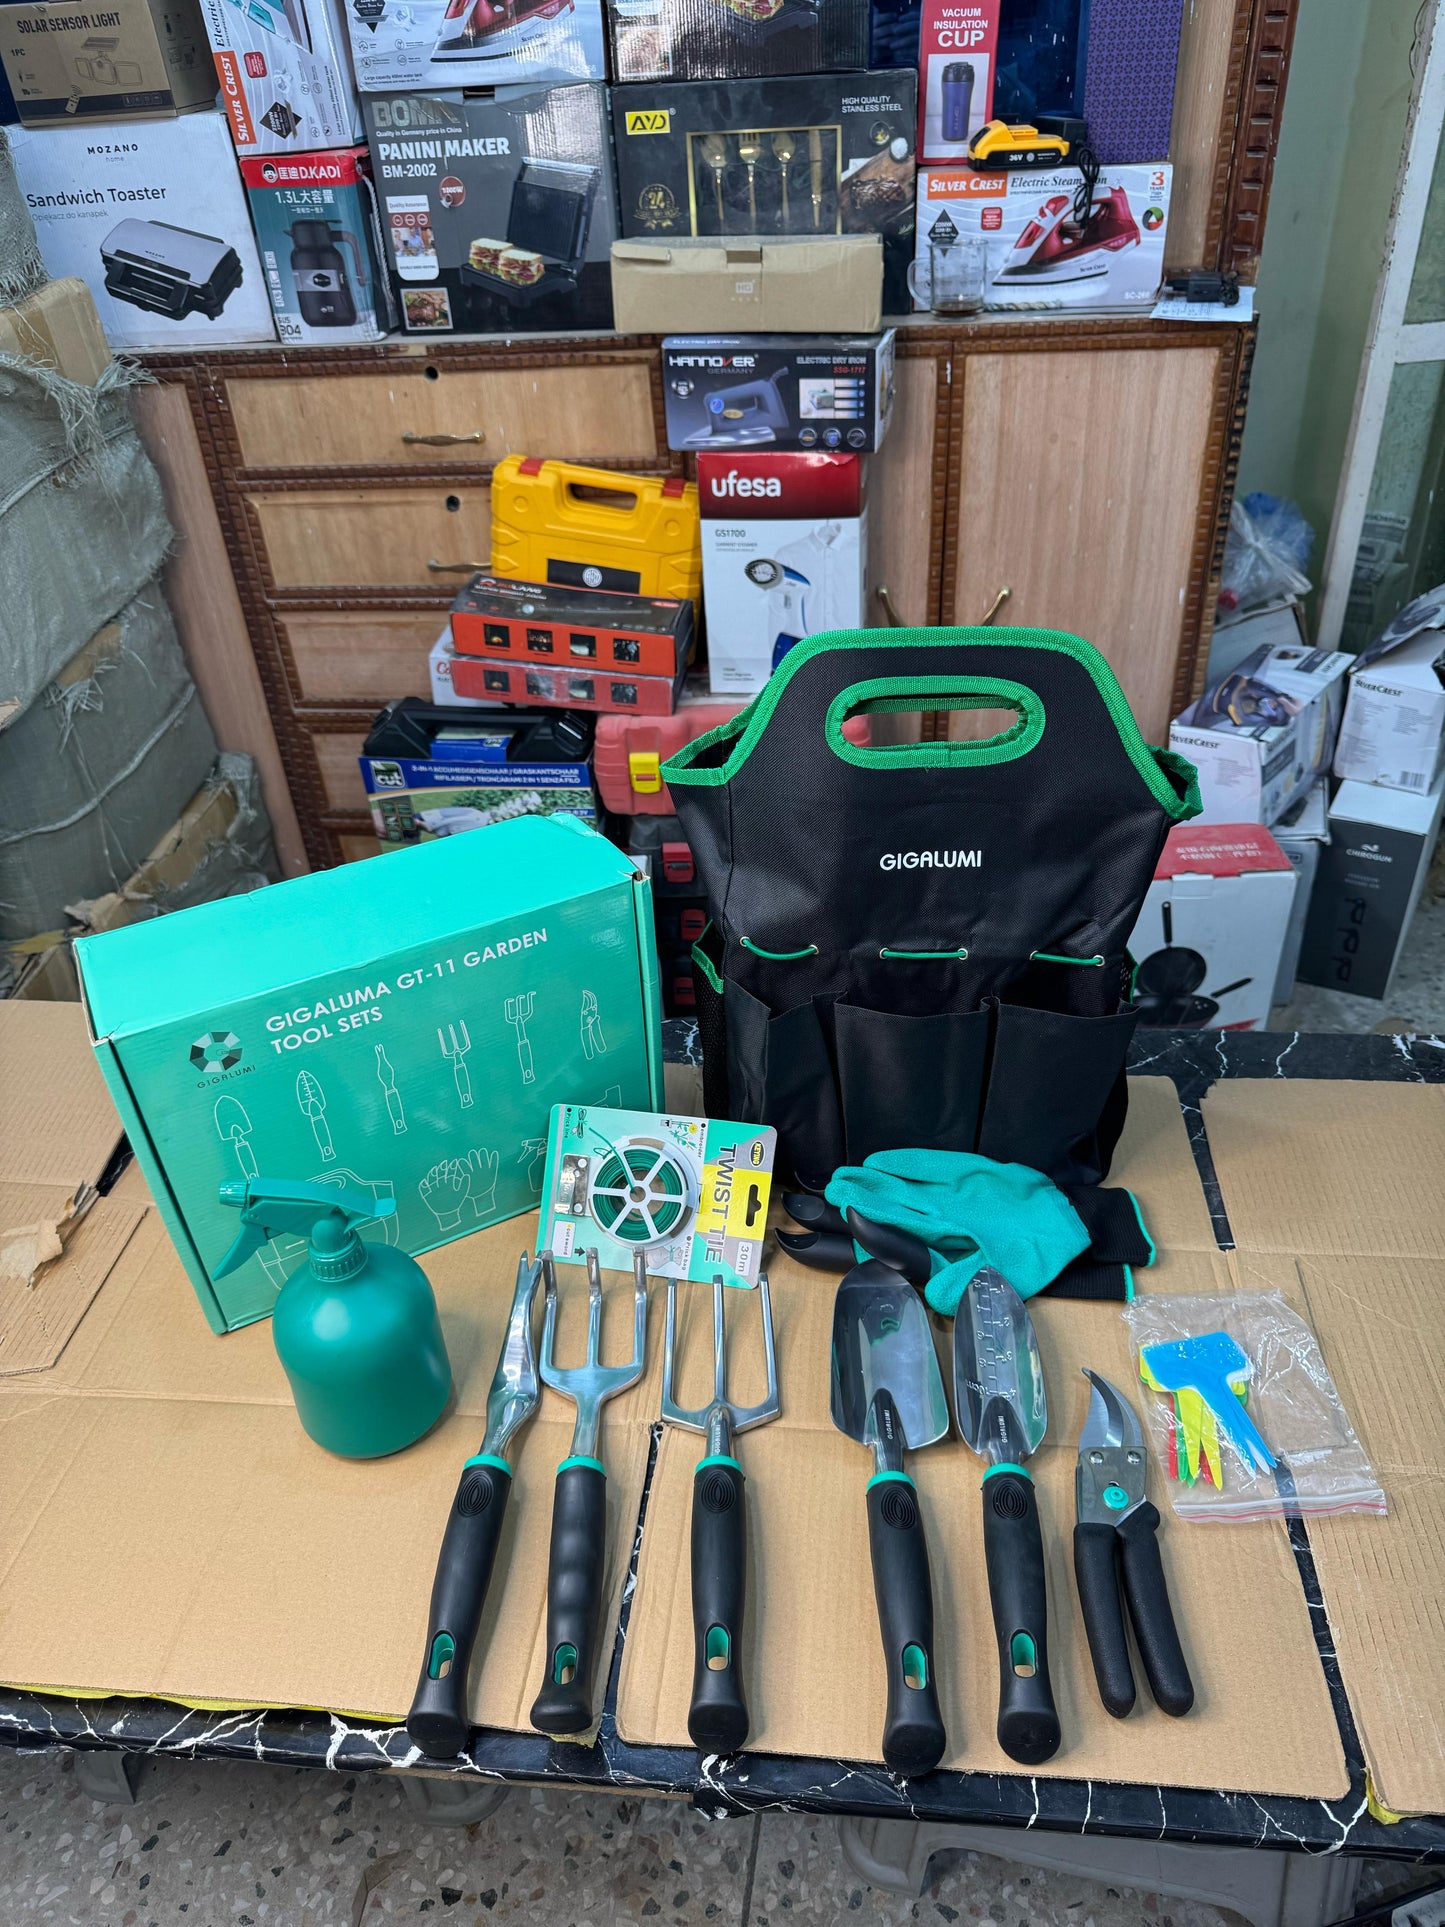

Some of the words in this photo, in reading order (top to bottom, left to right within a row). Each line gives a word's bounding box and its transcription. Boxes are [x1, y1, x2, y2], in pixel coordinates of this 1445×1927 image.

[942, 8, 982, 17] VACUUM
[17, 20, 50, 34] SOLAR
[50, 16, 90, 31] SENSOR
[91, 12, 122, 28] LIGHT
[207, 0, 225, 47] Electric
[933, 19, 989, 29] INSULATION
[938, 30, 985, 47] CUP
[221, 56, 239, 96] CREST
[841, 97, 859, 105] HIGH
[860, 96, 891, 104] QUALITY
[841, 104, 879, 113] STAINLESS
[880, 103, 903, 112] STEEL
[231, 100, 250, 142] SILVER
[87, 143, 139, 155] MOZANO
[378, 140, 443, 161] PANINI
[444, 137, 511, 158] MAKER
[300, 165, 341, 180] D.KADI
[382, 163, 438, 178] BM-2002
[1151, 171, 1165, 186] 3
[929, 178, 967, 193] SILVER
[968, 177, 1005, 192] CREST
[1011, 176, 1050, 188] Electric
[1051, 175, 1082, 187] Steam
[26, 189, 105, 209] Sandwich
[107, 186, 167, 203] Toaster
[66, 212, 76, 220] do
[77, 209, 109, 219] kanapek
[279, 324, 302, 336] 304
[668, 355, 756, 367] HANNOVER
[796, 356, 831, 364] ELECTRIC
[832, 356, 847, 364] DRY
[848, 356, 867, 364] IRON
[711, 469, 782, 497] ufesa
[715, 529, 746, 537] GS1700
[376, 771, 403, 786] cut
[879, 850, 982, 871] GIGALUMI
[265, 981, 392, 1033] GIGALUMA
[396, 959, 456, 990] GT-11
[463, 928, 548, 968] GARDEN
[270, 1025, 333, 1055] TOOL
[338, 1006, 383, 1033] SETS
[197, 1064, 257, 1090] GIGALUMI
[711, 1143, 738, 1220] TWIST
[704, 1224, 727, 1263] TIE
[737, 1245, 750, 1272] 30m
[883, 1409, 894, 1440] GIGALUMI
[997, 1415, 1008, 1443] GIGALUMI
